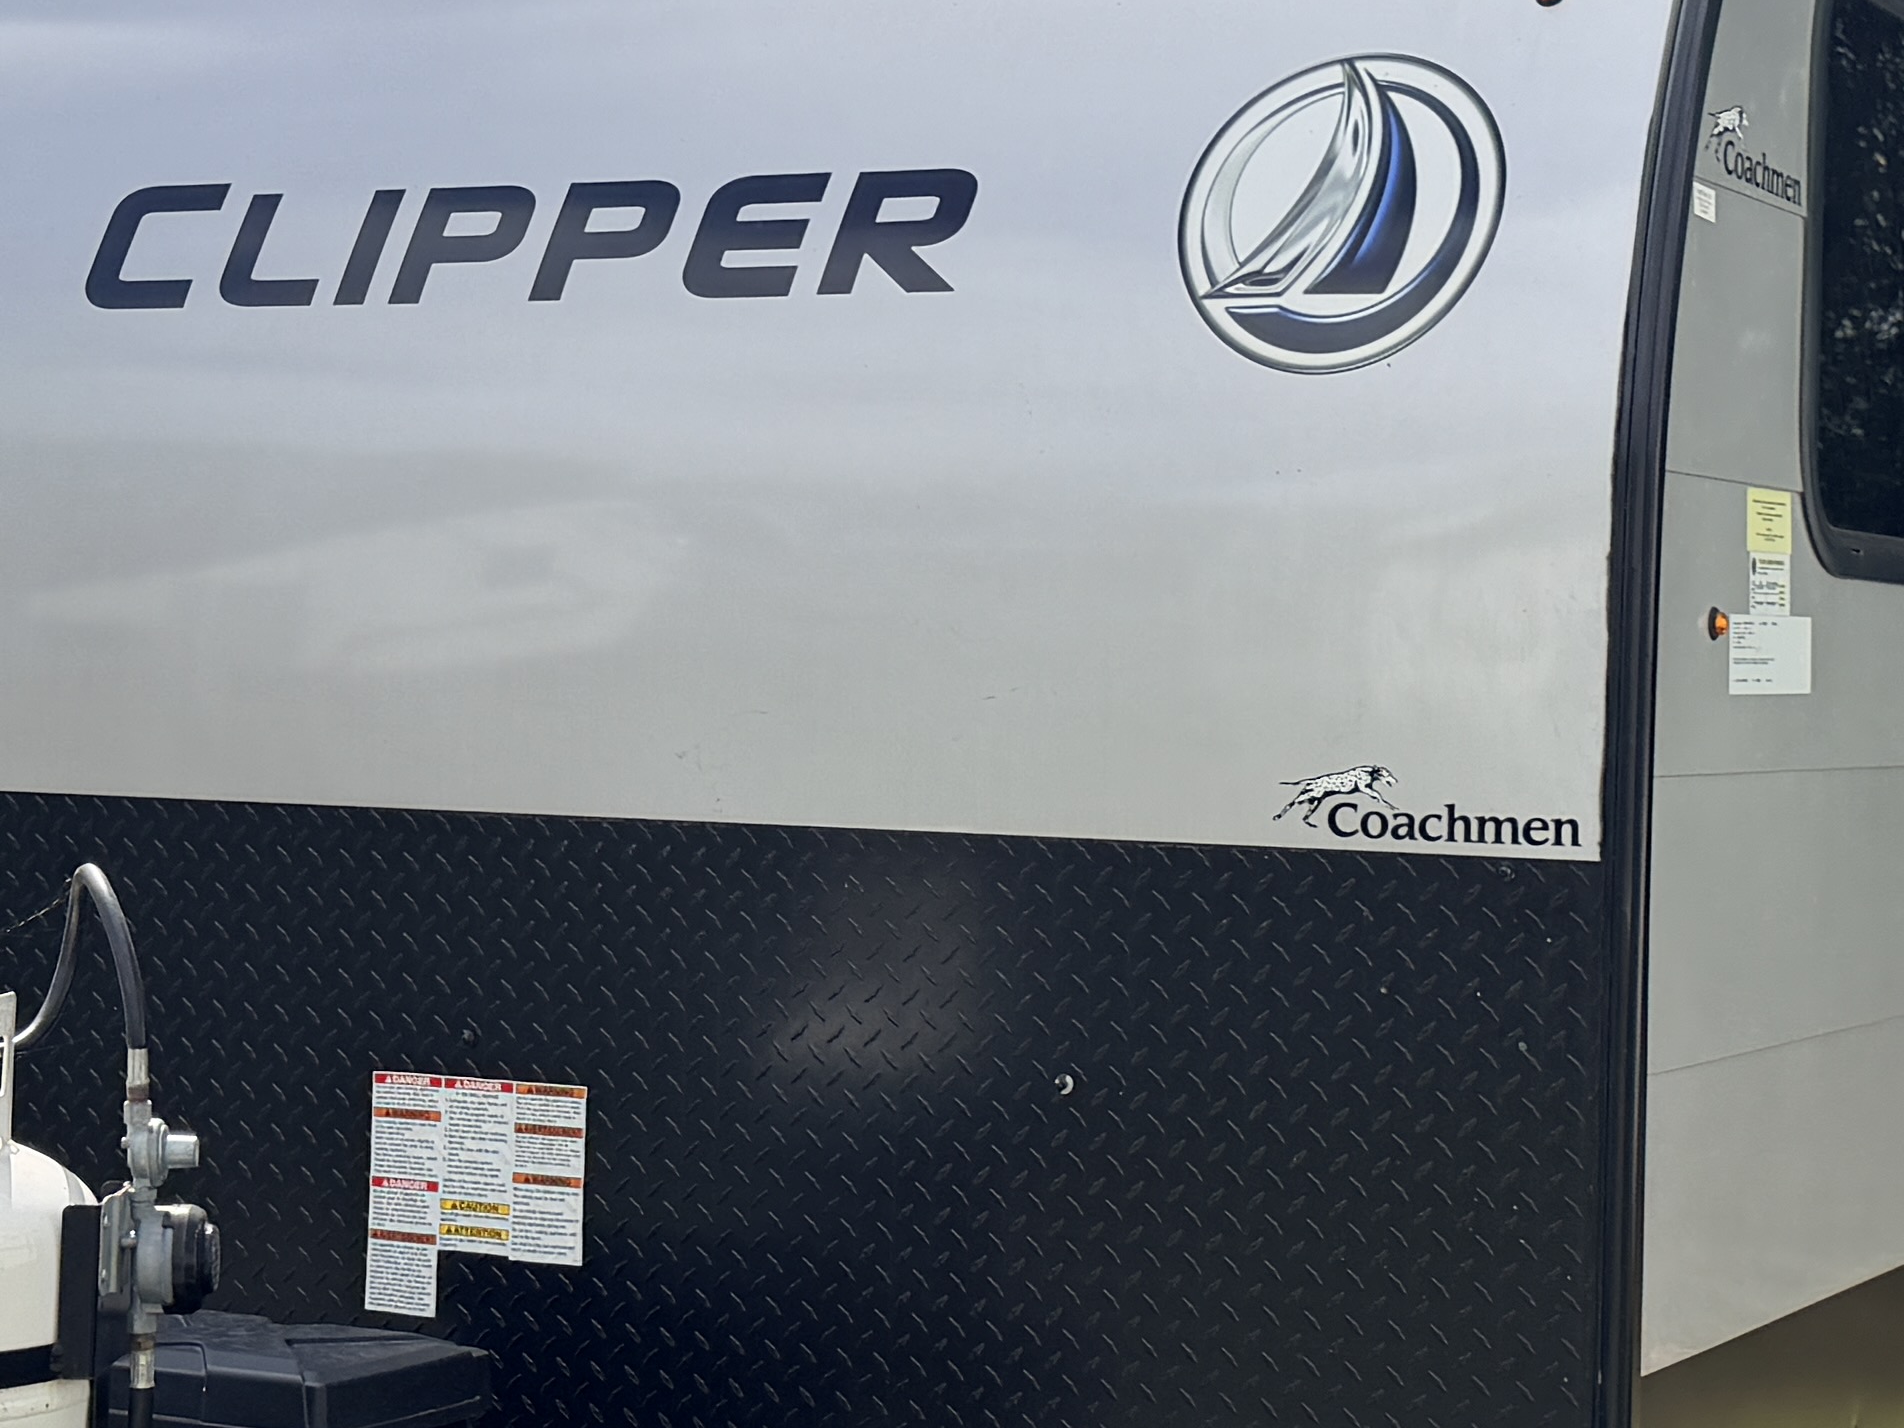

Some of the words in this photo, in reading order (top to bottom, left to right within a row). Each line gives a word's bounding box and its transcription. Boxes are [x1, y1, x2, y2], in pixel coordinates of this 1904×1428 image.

[1723, 140, 1802, 207] Coachmen
[84, 168, 979, 310] CLIPPER
[1327, 802, 1583, 847] Coachmen
[392, 1075, 431, 1086] DANGER
[462, 1080, 502, 1091] DANGER
[390, 1178, 429, 1190] DANGER
